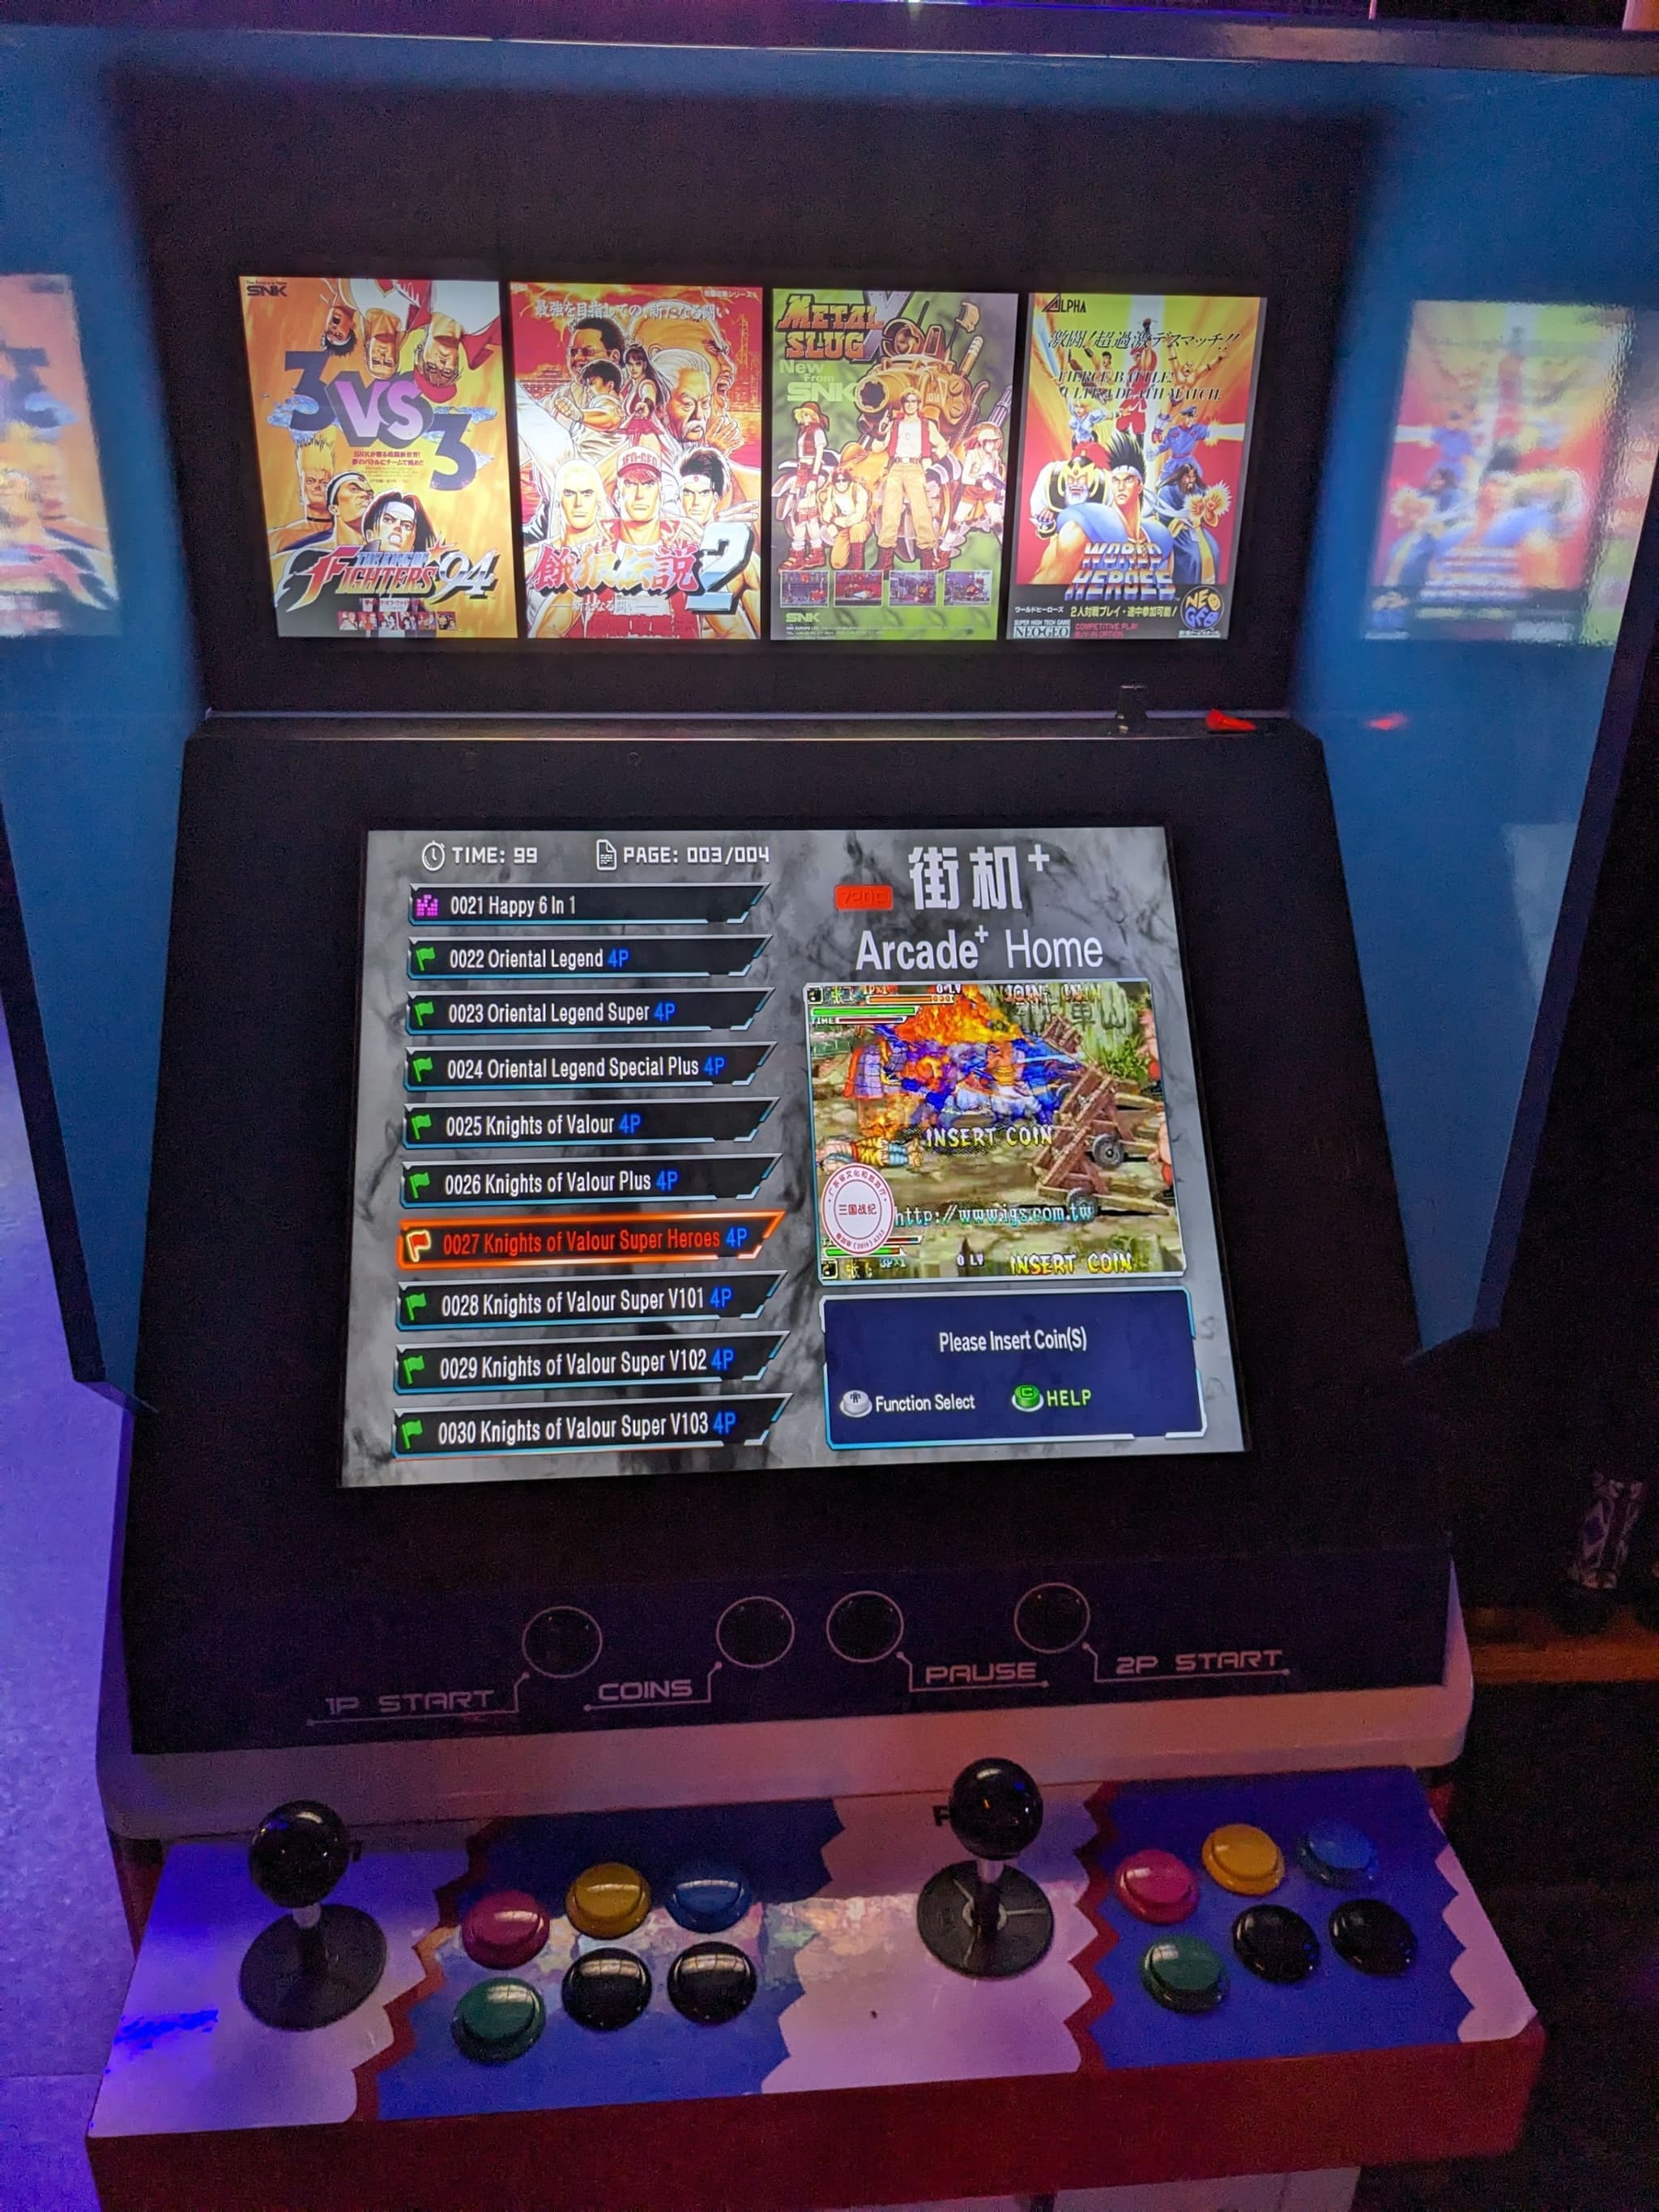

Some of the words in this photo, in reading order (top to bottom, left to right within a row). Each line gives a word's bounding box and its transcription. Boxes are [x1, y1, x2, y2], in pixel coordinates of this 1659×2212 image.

[246, 285, 288, 296] SNK
[777, 295, 883, 330] METAL
[785, 330, 864, 360] SLUG
[779, 360, 824, 374] New
[284, 351, 337, 432] 3
[787, 381, 857, 402] SNK
[327, 374, 429, 445] VS
[428, 414, 477, 492] 3
[1082, 542, 1162, 569] WORLD
[285, 545, 437, 612] FIGHTERS
[1064, 569, 1176, 602] HEROES
[1185, 589, 1221, 612] NEO
[786, 612, 821, 623] SNK
[452, 846, 505, 864] TIME:
[514, 846, 538, 864] 99
[623, 846, 679, 865] PAGE:
[450, 896, 484, 916] 0021
[488, 896, 535, 918] Happy
[539, 896, 548, 914] 6
[552, 896, 565, 914] In
[568, 895, 576, 914] 1
[450, 949, 484, 969] 0022
[488, 948, 547, 968] Oriental
[551, 948, 603, 970] Legend
[607, 946, 630, 967] 4P
[1005, 929, 1103, 969] Home
[449, 1004, 484, 1024] 0023
[488, 1004, 547, 1023] Oriental
[551, 1003, 603, 1025] Legend
[608, 1003, 650, 1024] Super
[654, 1002, 676, 1021] 4P
[448, 1060, 484, 1080] 0024
[488, 1059, 547, 1079] Oriental
[551, 1058, 606, 1081] Legend
[609, 1057, 663, 1079] Special
[667, 1056, 699, 1076] Plus
[704, 1056, 726, 1075] 4P
[446, 1117, 482, 1136] 0025
[486, 1116, 544, 1139] Knights
[548, 1115, 564, 1135] of
[566, 1115, 615, 1134] Valour
[618, 1114, 642, 1133] 4P
[926, 1127, 996, 1148] INSERT
[1006, 1125, 1053, 1146] COIN
[445, 1175, 481, 1196] 0026
[485, 1174, 543, 1198] Knights
[547, 1173, 563, 1193] of
[566, 1172, 615, 1192] Valour
[619, 1171, 651, 1191] Plus
[656, 1170, 678, 1191] 4P
[838, 1204, 877, 1216] 三国战纪
[443, 1234, 480, 1255] 0027
[484, 1234, 542, 1258] Knights
[546, 1232, 563, 1252] of
[566, 1230, 616, 1251] Valour
[619, 1230, 663, 1252] Super
[667, 1228, 720, 1249] Heroes
[726, 1227, 748, 1248] 4P
[1012, 1253, 1077, 1275] INSERT
[1087, 1252, 1133, 1273] COIN
[441, 1296, 479, 1316] 0028
[484, 1294, 542, 1319] Knights
[546, 1292, 563, 1313] of
[567, 1291, 616, 1312] Valour
[621, 1289, 664, 1312] Super
[668, 1288, 704, 1309] V101
[710, 1287, 732, 1308] 4P
[940, 1331, 987, 1352] Please
[990, 1328, 1032, 1350] Insert
[1034, 1326, 1087, 1352] Coin(S)
[440, 1358, 477, 1380] 0029
[482, 1356, 541, 1382] Knights
[546, 1354, 562, 1375] of
[566, 1353, 616, 1375] Valour
[621, 1351, 665, 1375] Super
[669, 1349, 707, 1371] V102
[711, 1349, 734, 1370] 4P
[876, 1395, 932, 1412] Function
[935, 1393, 975, 1410] Select
[1046, 1388, 1092, 1407] HELP
[438, 1423, 476, 1445] 0030
[480, 1420, 540, 1447] Knights
[545, 1418, 562, 1440] of
[566, 1417, 616, 1439] Valour
[621, 1415, 666, 1438] Super
[670, 1413, 709, 1435] V103
[713, 1412, 736, 1434] 4P
[925, 1661, 1037, 1684] PAUSE
[1115, 1656, 1159, 1674] 2P
[1175, 1649, 1283, 1672] START
[378, 1690, 494, 1712] START
[598, 1679, 693, 1701] COINS
